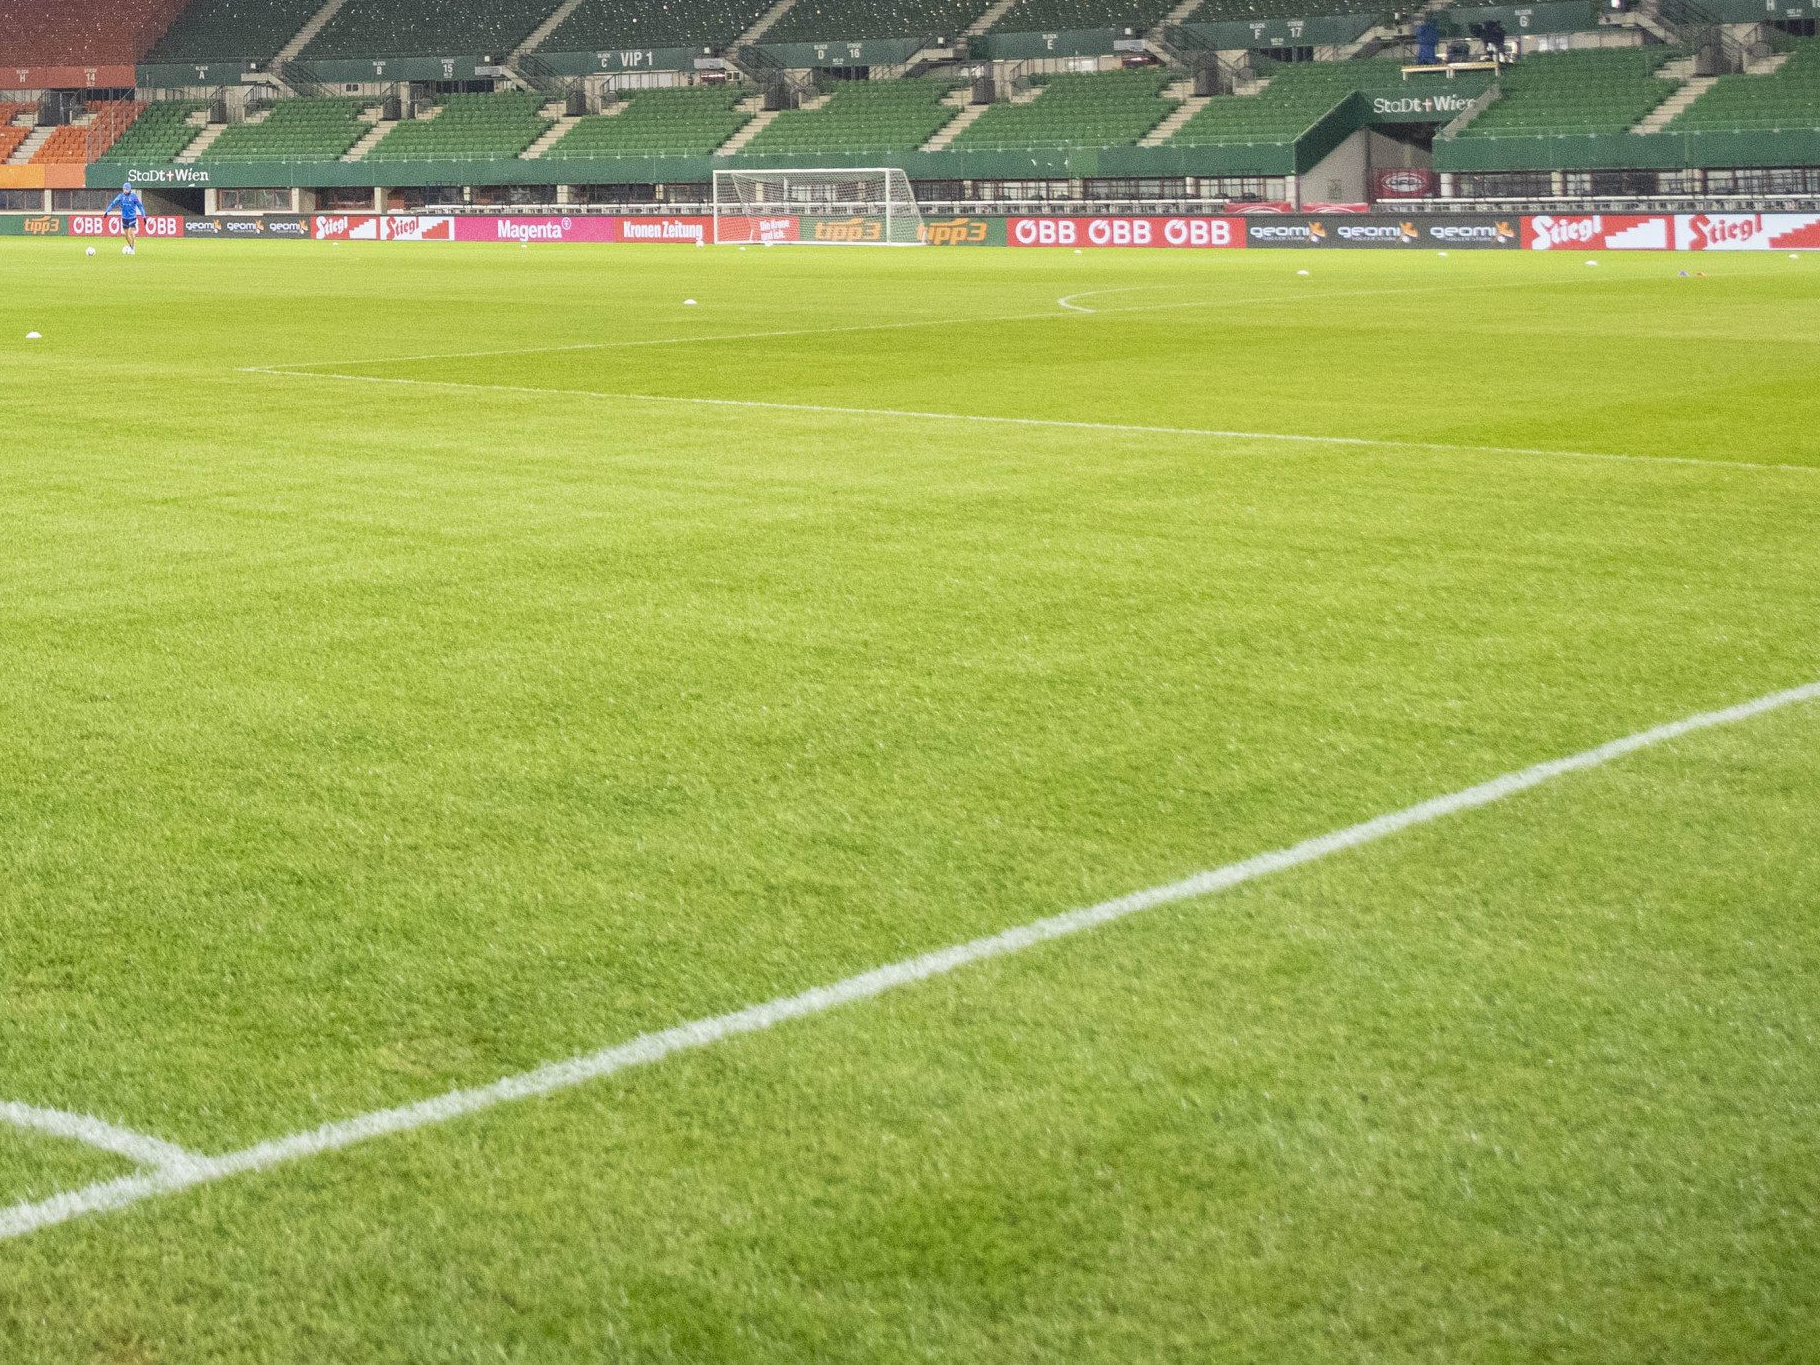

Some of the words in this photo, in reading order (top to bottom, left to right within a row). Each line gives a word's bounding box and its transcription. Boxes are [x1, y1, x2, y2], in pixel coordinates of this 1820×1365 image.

[1766, 0, 1775, 11] H
[1520, 16, 1527, 27] G
[1255, 29, 1260, 39] F
[1291, 27, 1301, 38] 17
[1048, 40, 1053, 49] E
[620, 52, 642, 67] VIP
[646, 51, 653, 66] 1
[849, 48, 860, 58] 16
[376, 66, 382, 75] B
[443, 64, 453, 73] 15
[601, 59, 608, 68] C
[87, 74, 95, 82] 14
[198, 71, 206, 80] A
[175, 168, 209, 182] Wien
[24, 216, 60, 234] tipp3
[73, 218, 103, 235] ÖBB
[145, 218, 177, 235] ÖBB
[316, 216, 348, 240] Stiegl
[386, 216, 419, 241] Stiegl
[497, 219, 562, 241] Magenta
[623, 221, 661, 238] Kronen
[662, 220, 703, 242] Zeitung
[815, 218, 881, 242] tipp3
[916, 218, 987, 245] tipp3
[1015, 219, 1076, 245] ÖBB
[1089, 219, 1151, 245] ÖBB
[1164, 219, 1230, 245] ÖBB
[1532, 215, 1601, 250] Stiegl
[1688, 214, 1763, 251] Stiegl
